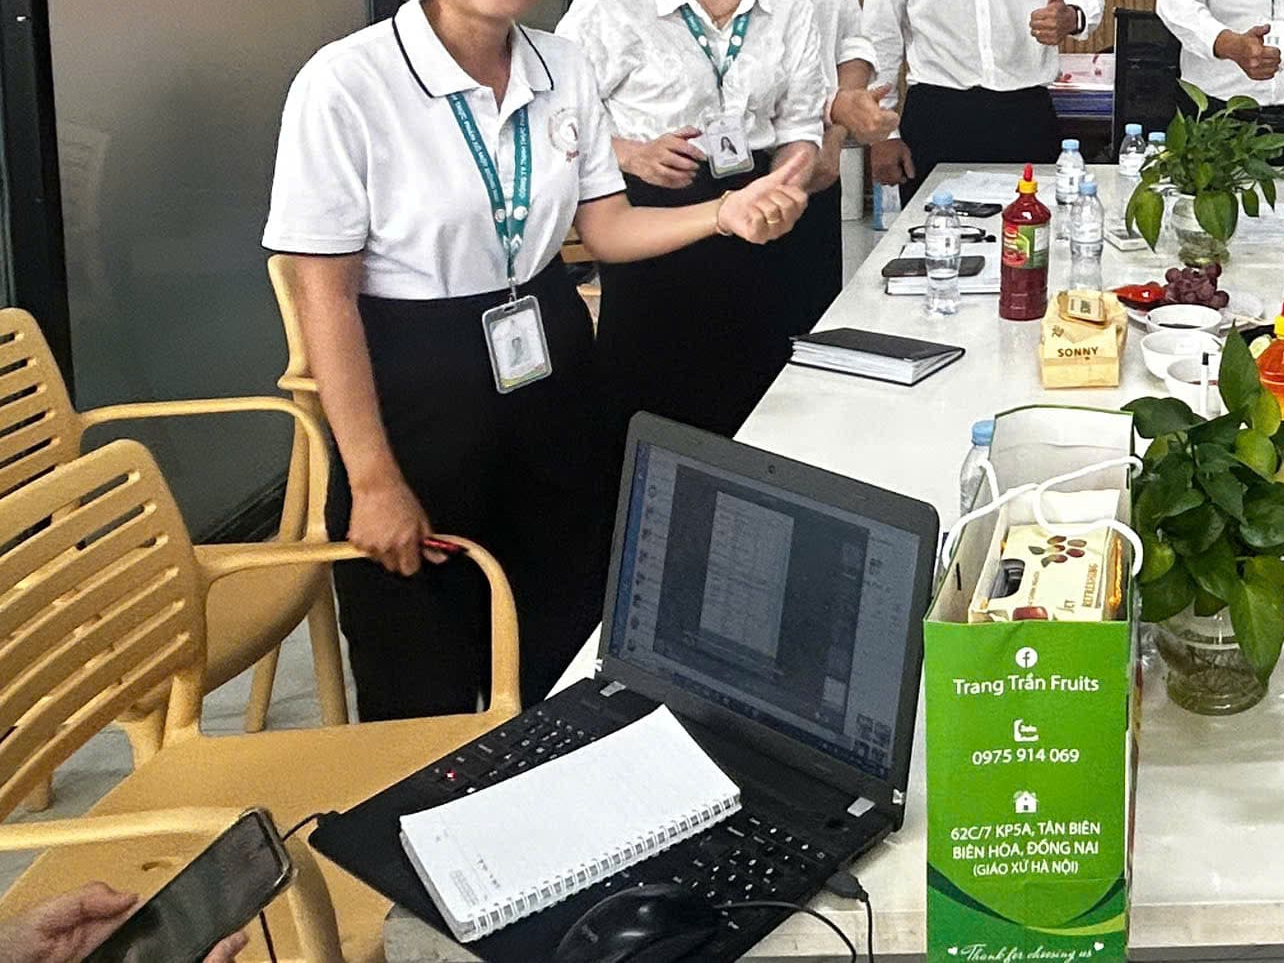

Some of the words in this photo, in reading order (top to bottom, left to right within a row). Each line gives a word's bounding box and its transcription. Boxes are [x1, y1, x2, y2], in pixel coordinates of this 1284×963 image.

[1057, 346, 1099, 358] SONNY
[952, 678, 1004, 696] Trang
[1008, 672, 1046, 691] Trần
[1050, 674, 1100, 692] Fruits
[972, 748, 1012, 766] 0975
[1016, 747, 1046, 762] 914
[1049, 748, 1080, 763] 069
[951, 825, 992, 841] 62C/7
[995, 822, 1035, 837] KP5A,
[1037, 820, 1066, 835] TÂN
[1069, 820, 1101, 835] BIÊN
[952, 844, 985, 860] BIÊN
[988, 841, 1024, 858] HÒA,
[1074, 841, 1099, 854] NAI
[973, 863, 1009, 878] (GIÁO
[1031, 859, 1050, 874] HÀ
[1051, 860, 1079, 875] NỘI)
[960, 943, 1008, 962] Thank
[1003, 946, 1024, 963] for
[1026, 945, 1077, 962] choosing
[1078, 948, 1093, 958] us
